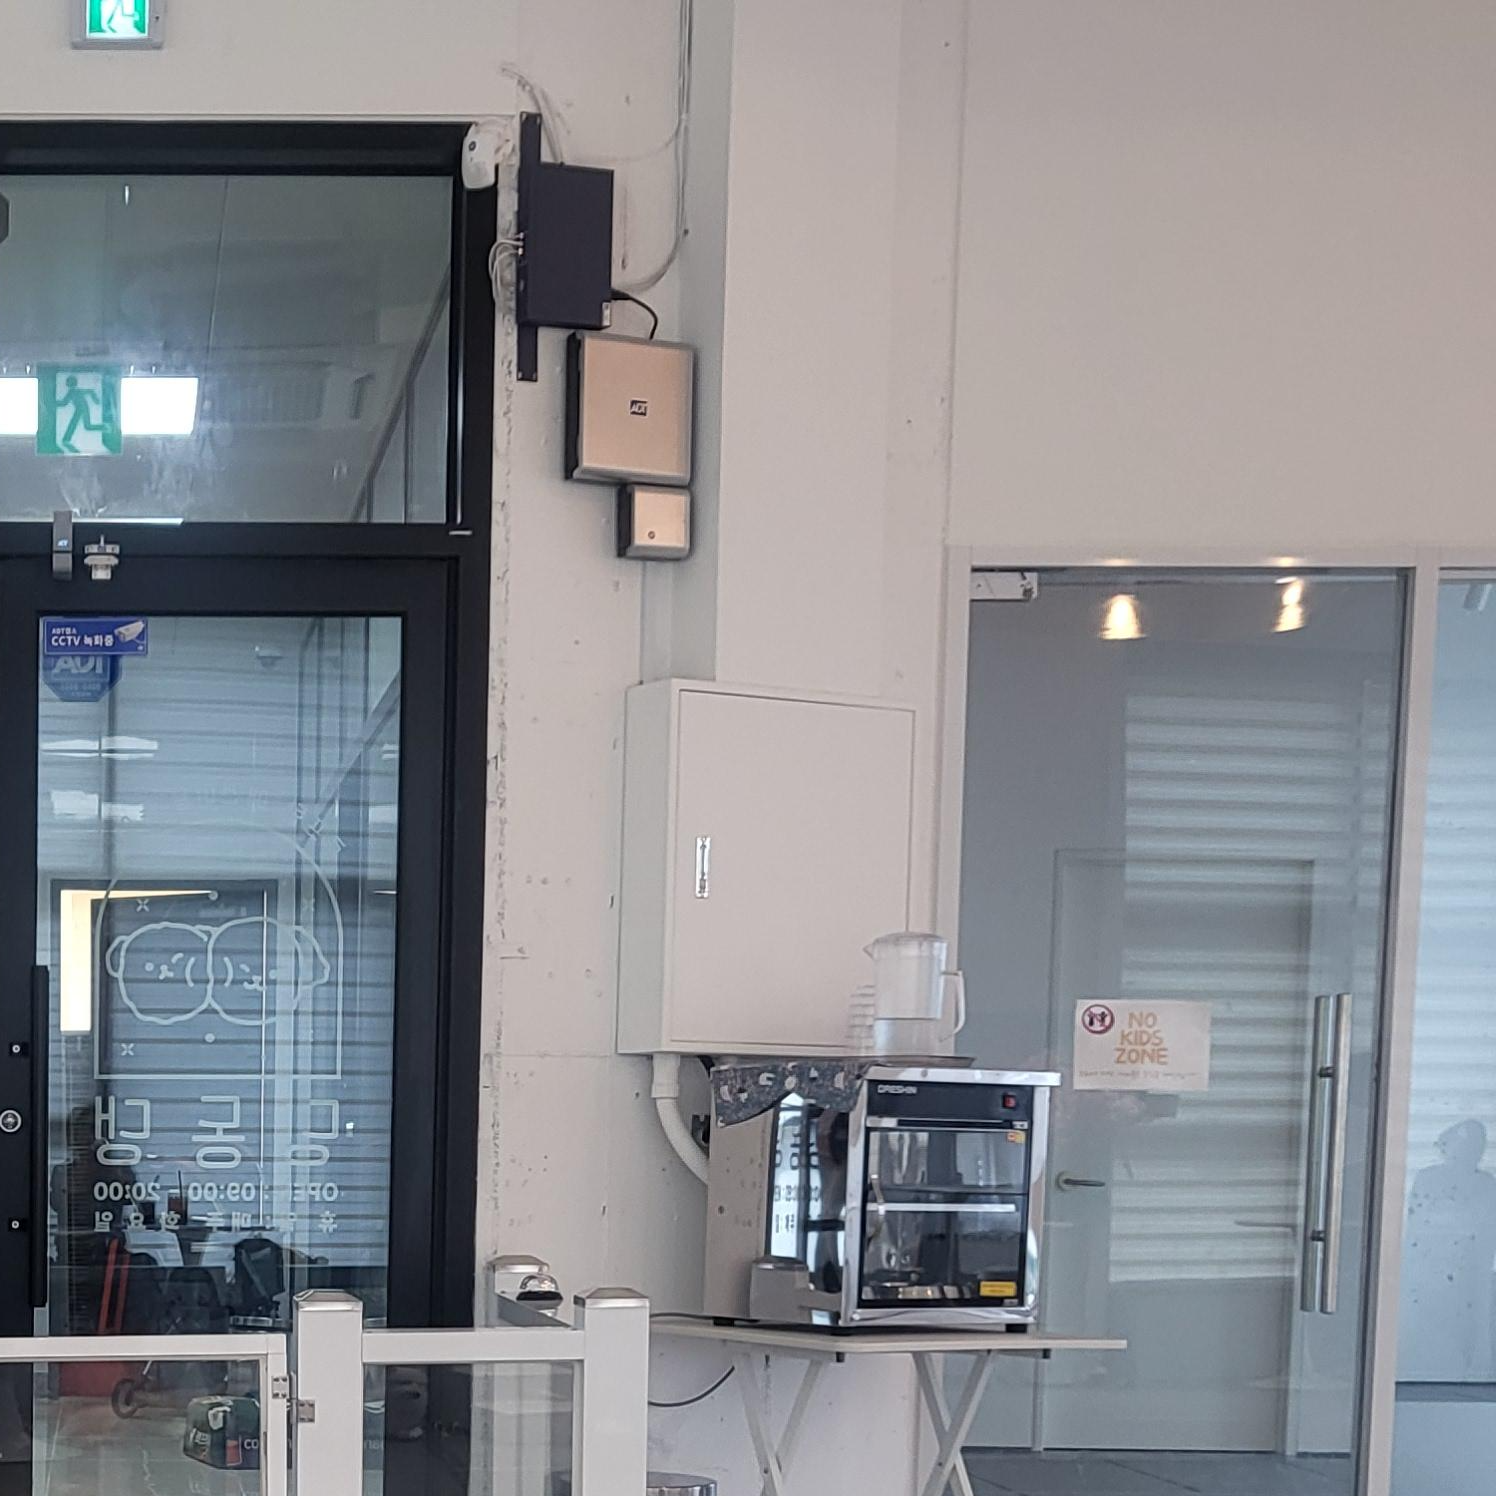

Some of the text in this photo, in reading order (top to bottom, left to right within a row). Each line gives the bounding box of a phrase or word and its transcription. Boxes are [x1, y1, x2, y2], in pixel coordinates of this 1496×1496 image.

[51, 635, 81, 647] CCTV
[1128, 1011, 1158, 1029] NO
[1120, 1029, 1164, 1047] KIDS
[1115, 1047, 1169, 1065] ZONE
